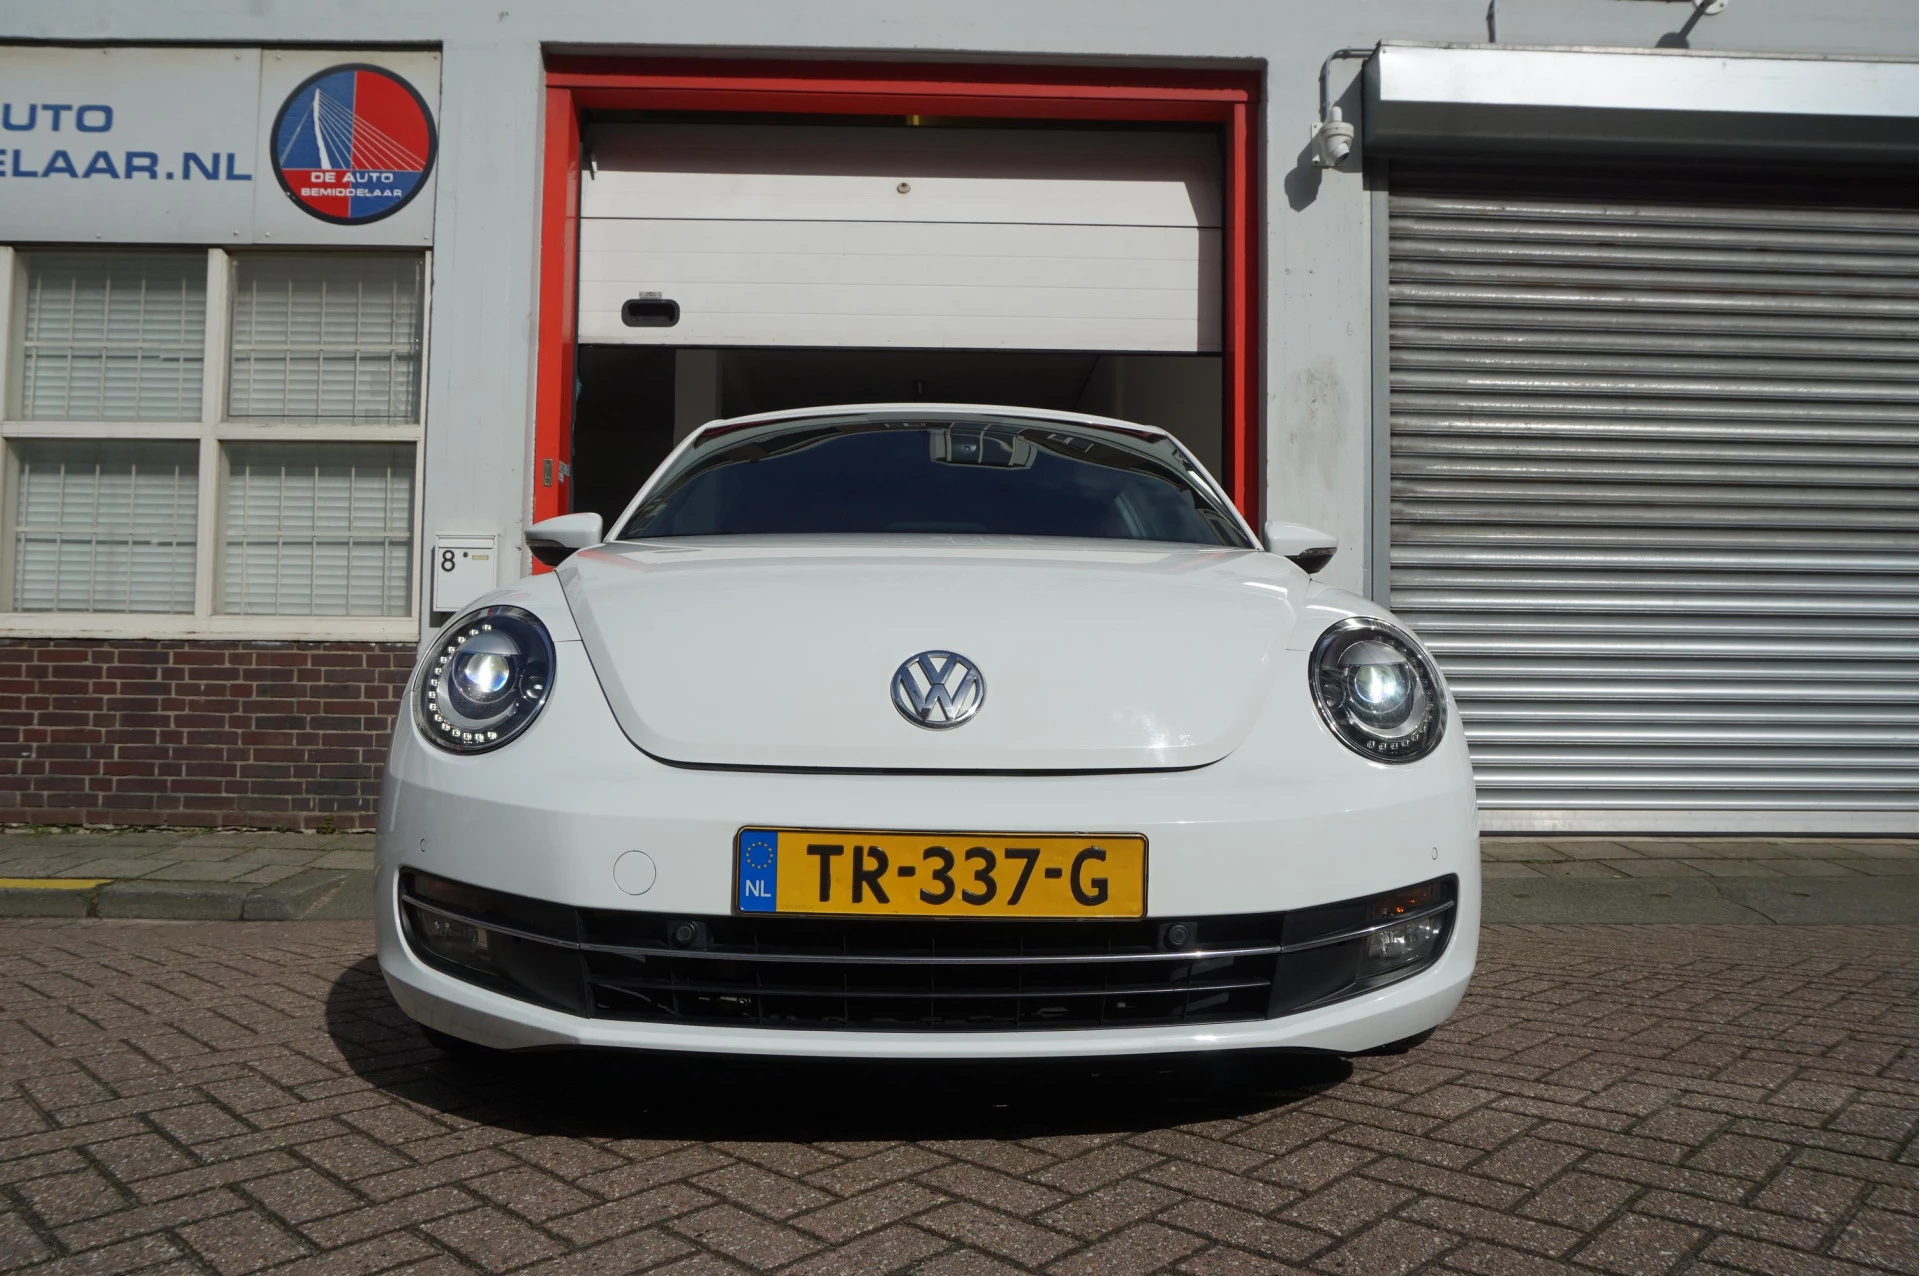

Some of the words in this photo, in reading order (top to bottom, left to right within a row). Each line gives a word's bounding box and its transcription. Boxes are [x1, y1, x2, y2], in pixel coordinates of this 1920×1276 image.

[0, 148, 253, 182] LAAR.NL
[310, 171, 336, 183] DE
[342, 172, 394, 183] AUTO
[301, 187, 402, 198] BEMIDDELAAR
[441, 549, 455, 572] 8
[745, 879, 771, 898] NL
[806, 844, 1109, 907] TR-337-G
